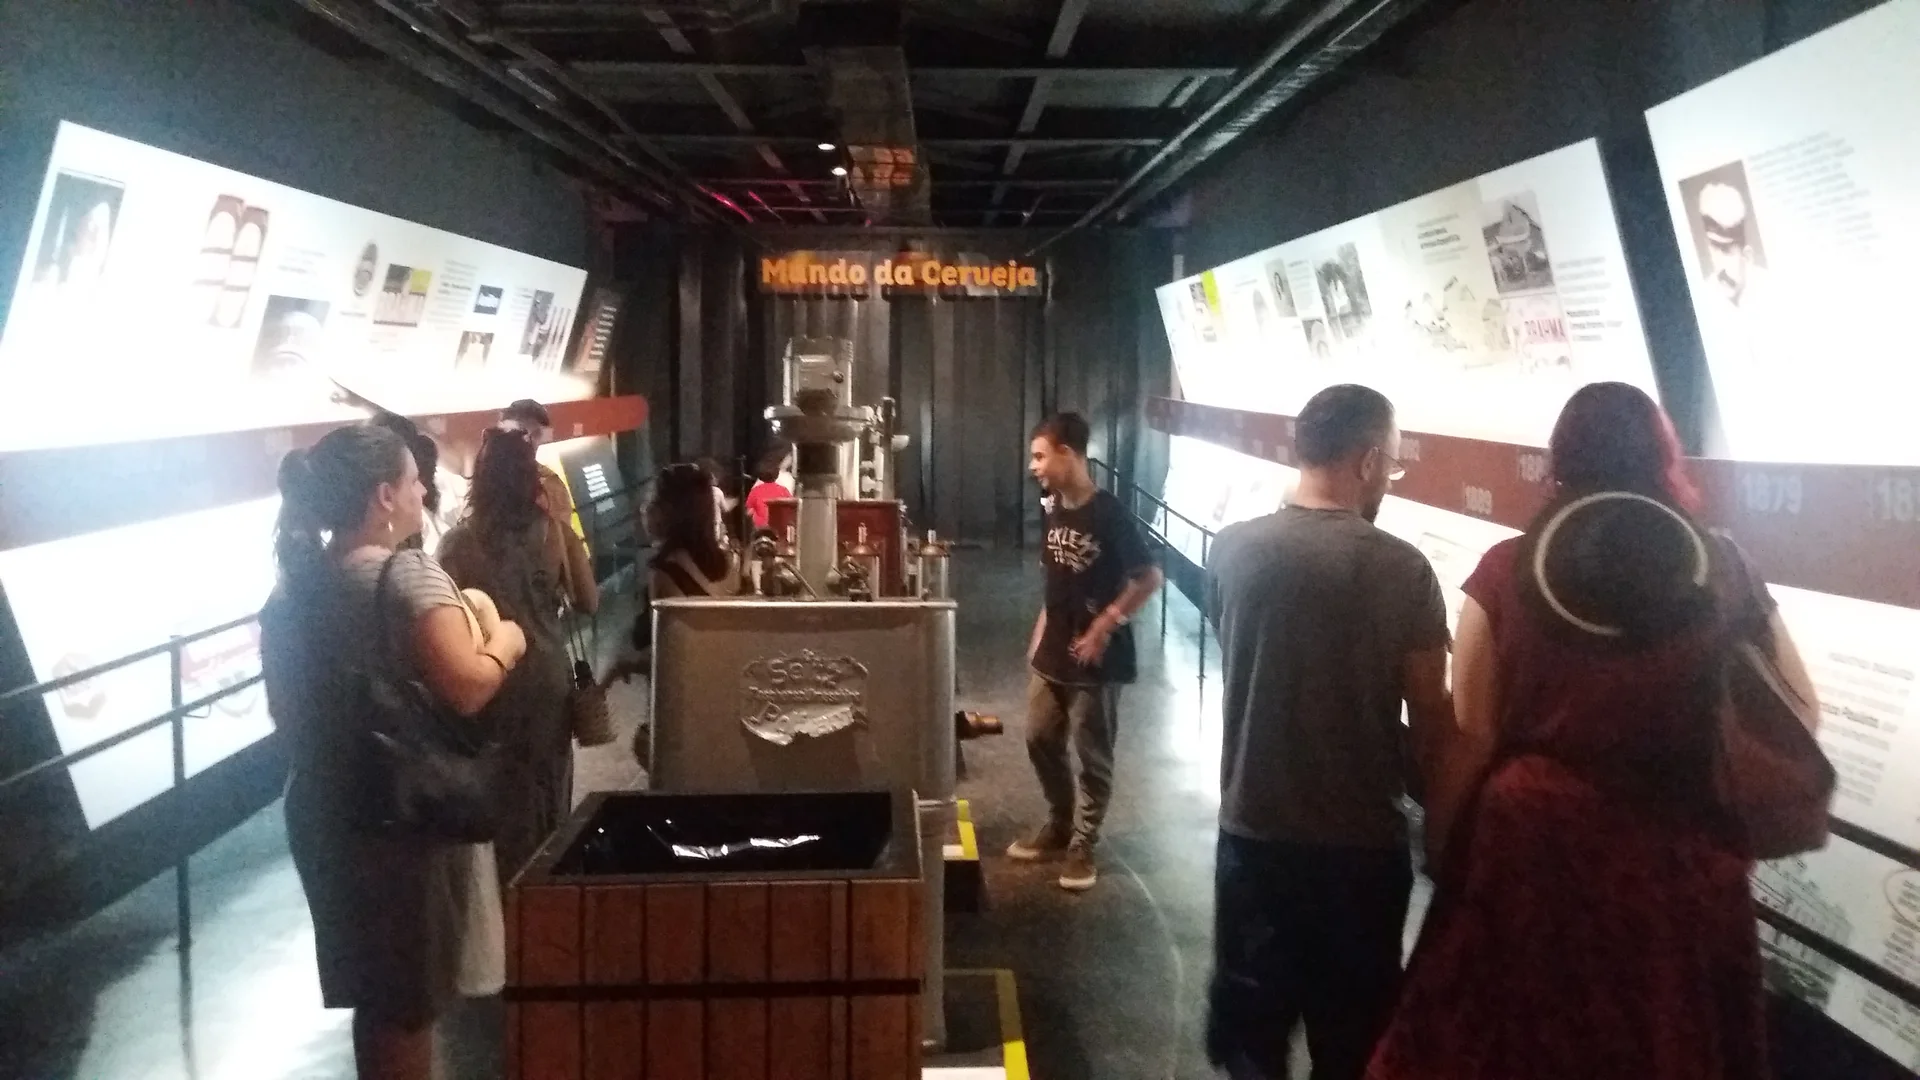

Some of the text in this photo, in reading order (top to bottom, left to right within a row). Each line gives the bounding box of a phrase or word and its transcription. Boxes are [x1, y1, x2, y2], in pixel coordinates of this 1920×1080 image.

[762, 258, 866, 285] Mundo
[874, 259, 914, 286] da
[1741, 472, 1803, 515] 1879
[1876, 477, 1920, 522] 18
